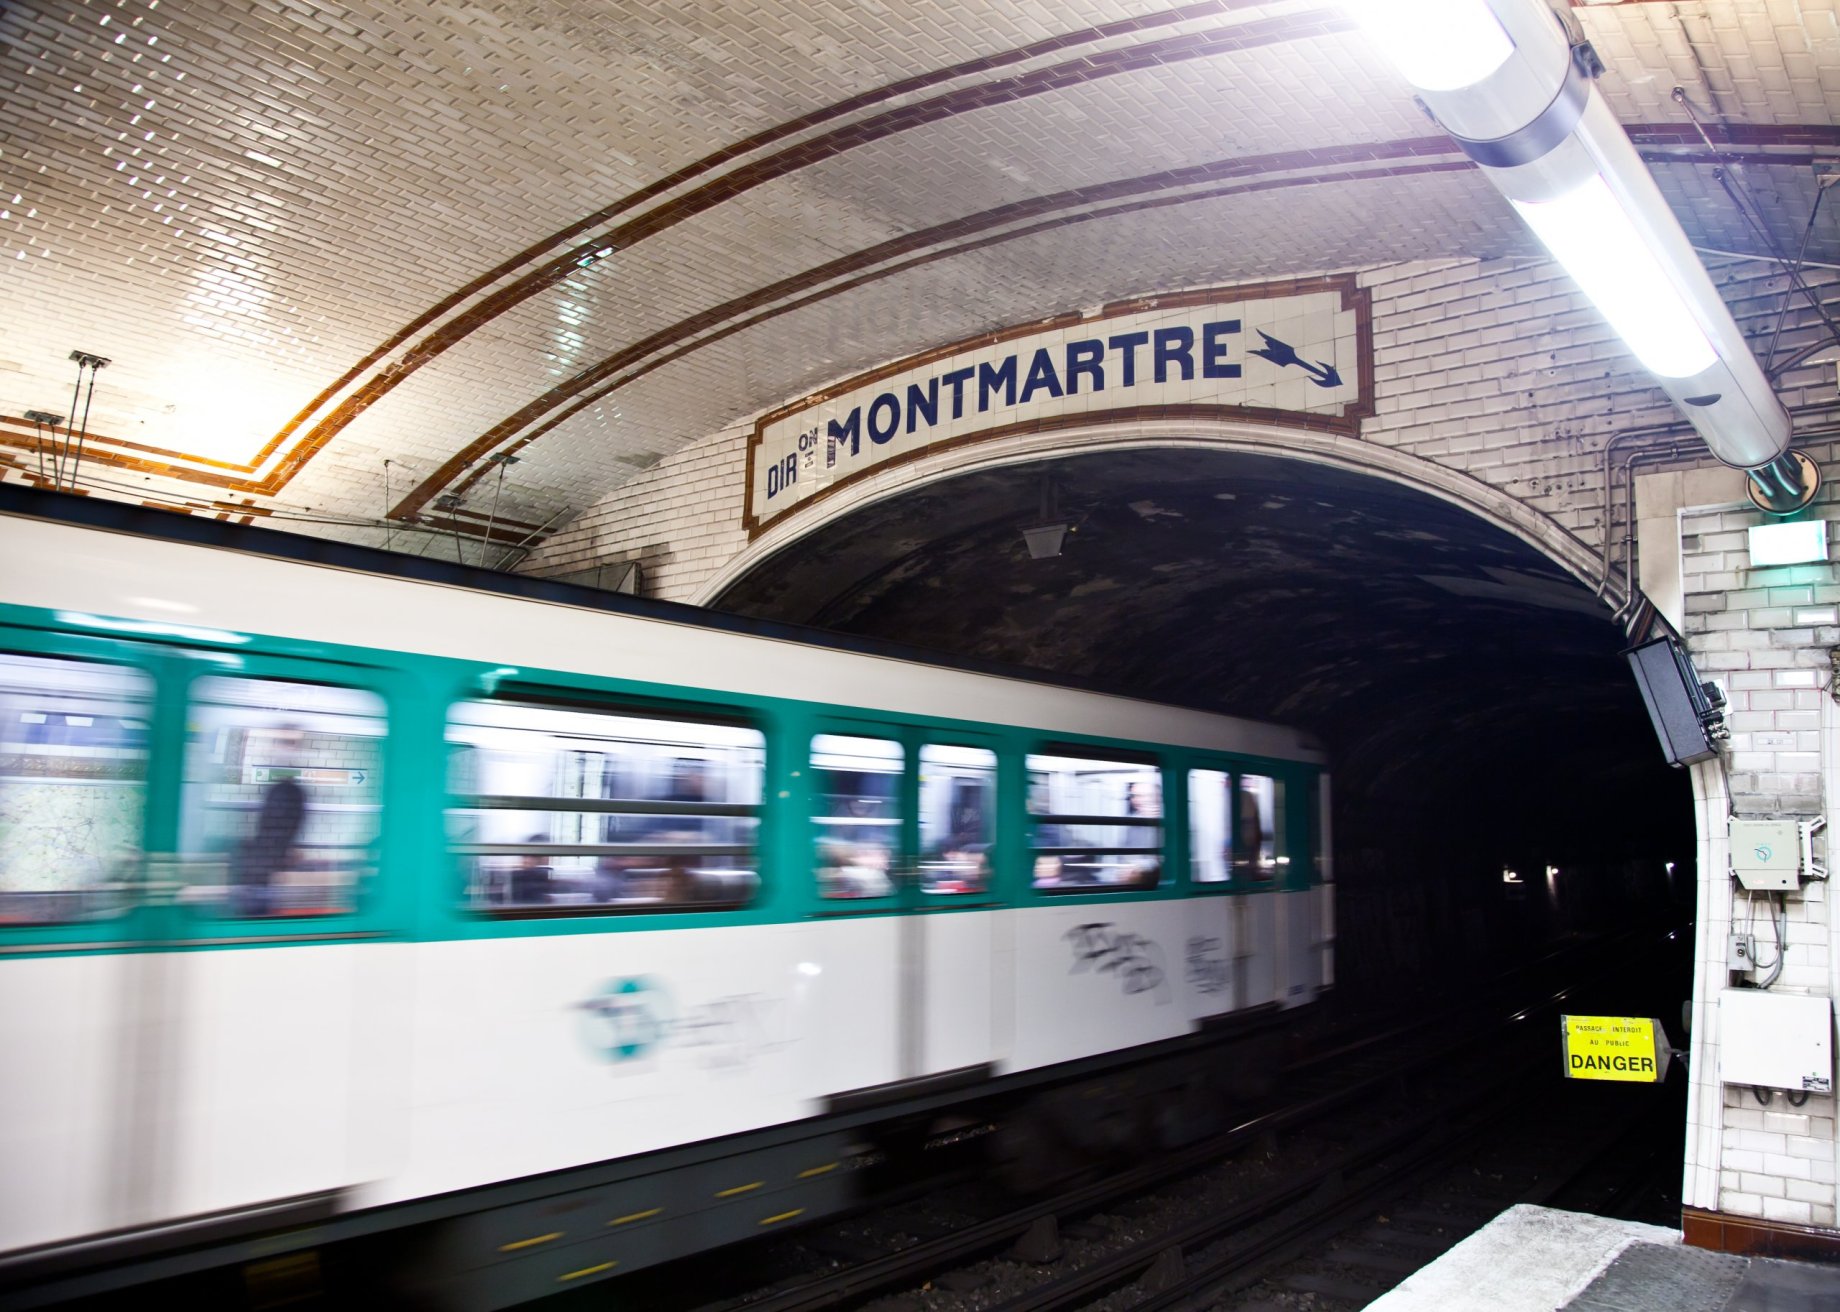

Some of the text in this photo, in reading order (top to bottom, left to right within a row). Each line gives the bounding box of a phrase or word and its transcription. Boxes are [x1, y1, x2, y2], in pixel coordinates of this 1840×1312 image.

[826, 319, 1242, 469] MONTMARTRE
[1612, 1026, 1642, 1034] INTERDIT
[1605, 1039, 1630, 1047] PUBLIC
[1571, 1054, 1654, 1073] DANGER
